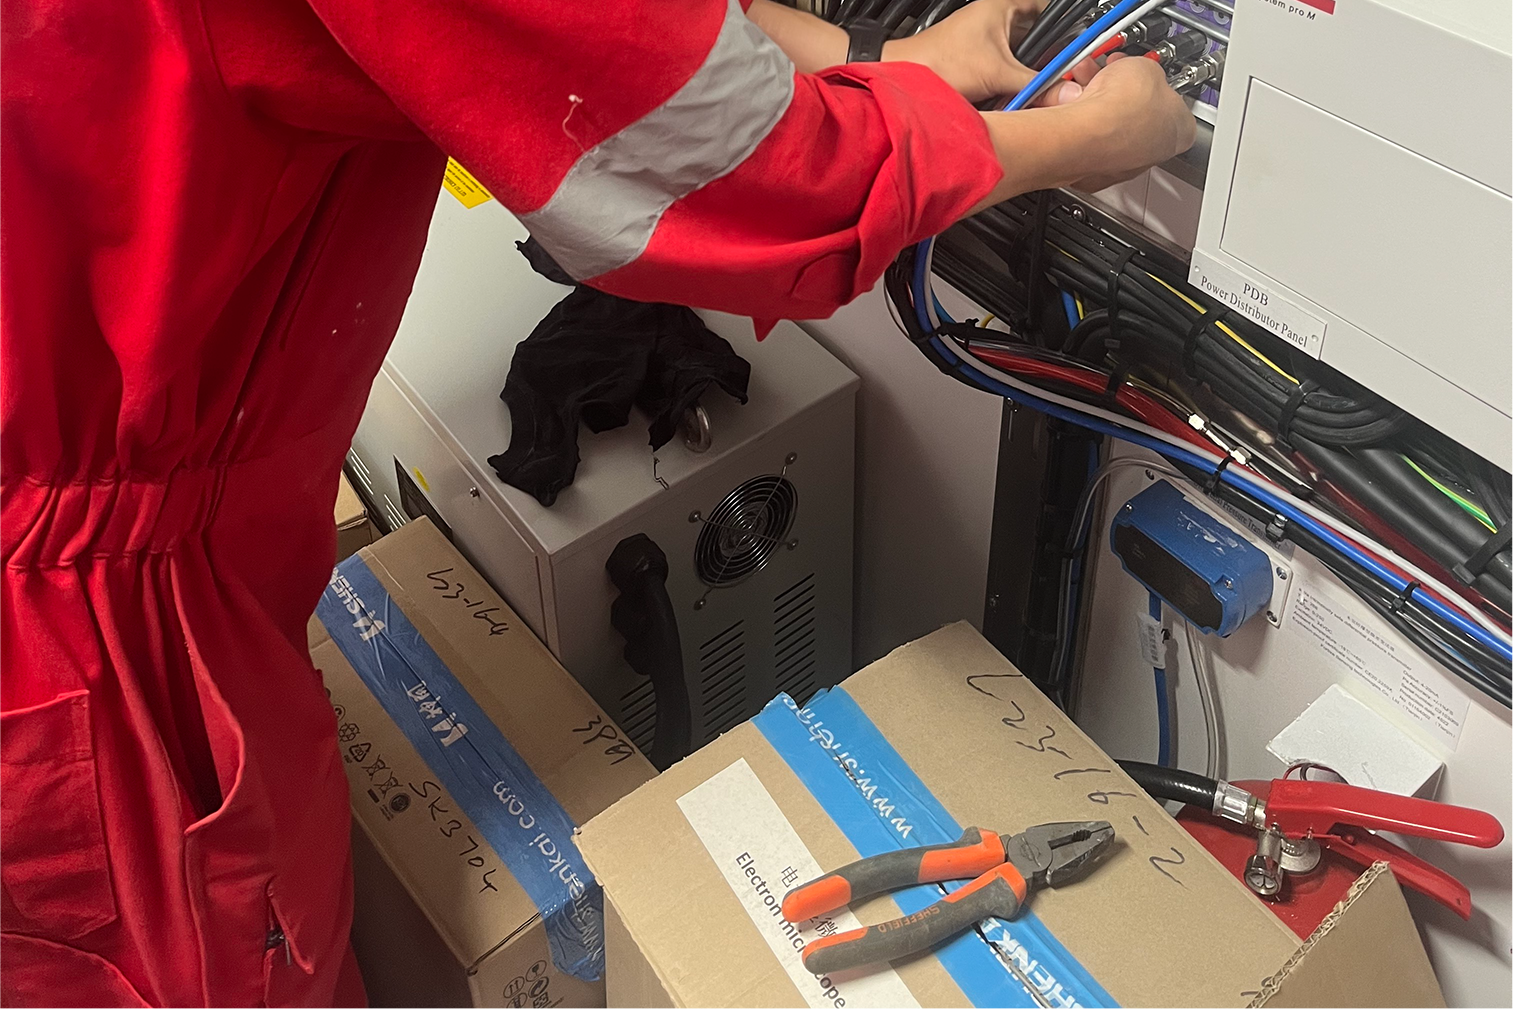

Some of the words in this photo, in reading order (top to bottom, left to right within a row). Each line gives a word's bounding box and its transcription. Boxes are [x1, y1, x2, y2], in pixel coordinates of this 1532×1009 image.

[1288, 5, 1304, 16] pro
[1307, 11, 1316, 20] M
[1201, 276, 1227, 300] Power
[1230, 293, 1279, 331] Distributor
[1281, 323, 1307, 347] Panel
[1243, 283, 1268, 306] PDB
[409, 781, 498, 893] SK3704
[735, 851, 782, 917] Electron
[877, 905, 940, 933] SHEFFIELD
